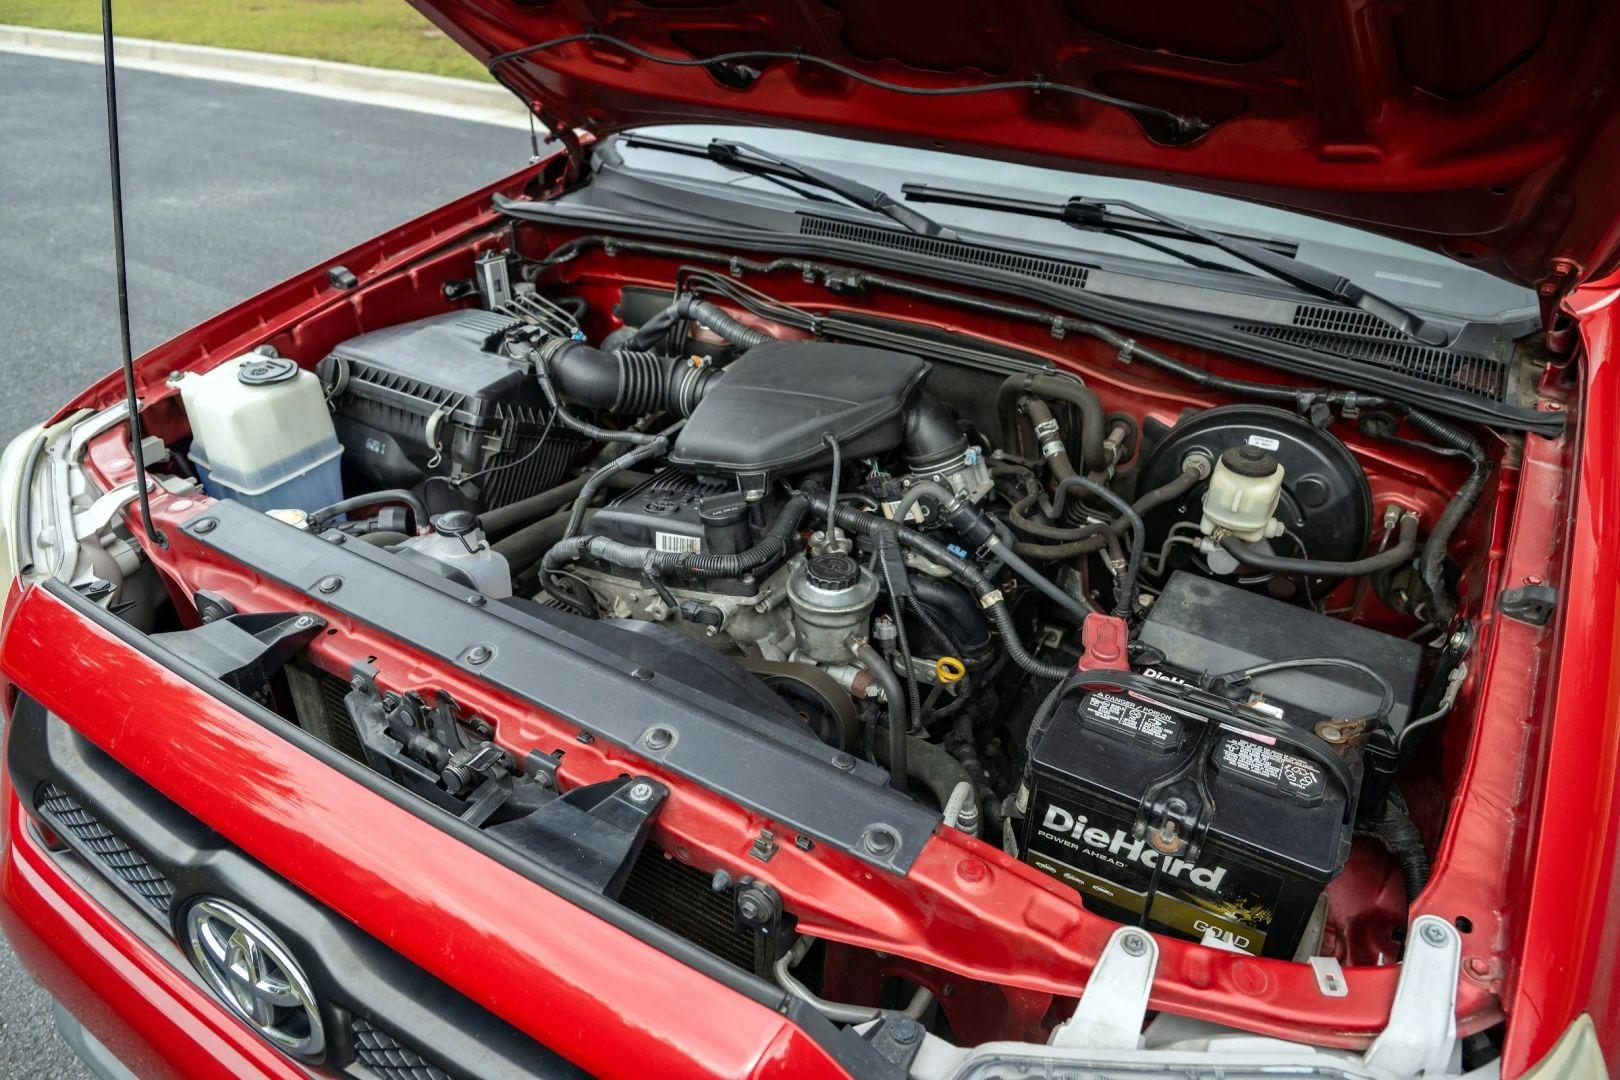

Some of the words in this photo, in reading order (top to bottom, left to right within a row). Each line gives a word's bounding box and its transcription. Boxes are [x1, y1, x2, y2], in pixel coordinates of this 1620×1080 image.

[1104, 693, 1136, 708] DANGER
[1143, 706, 1172, 720] POISON
[1037, 829, 1079, 850] POWER
[1082, 848, 1126, 868] AHEAD
[1042, 804, 1227, 892] DieHard
